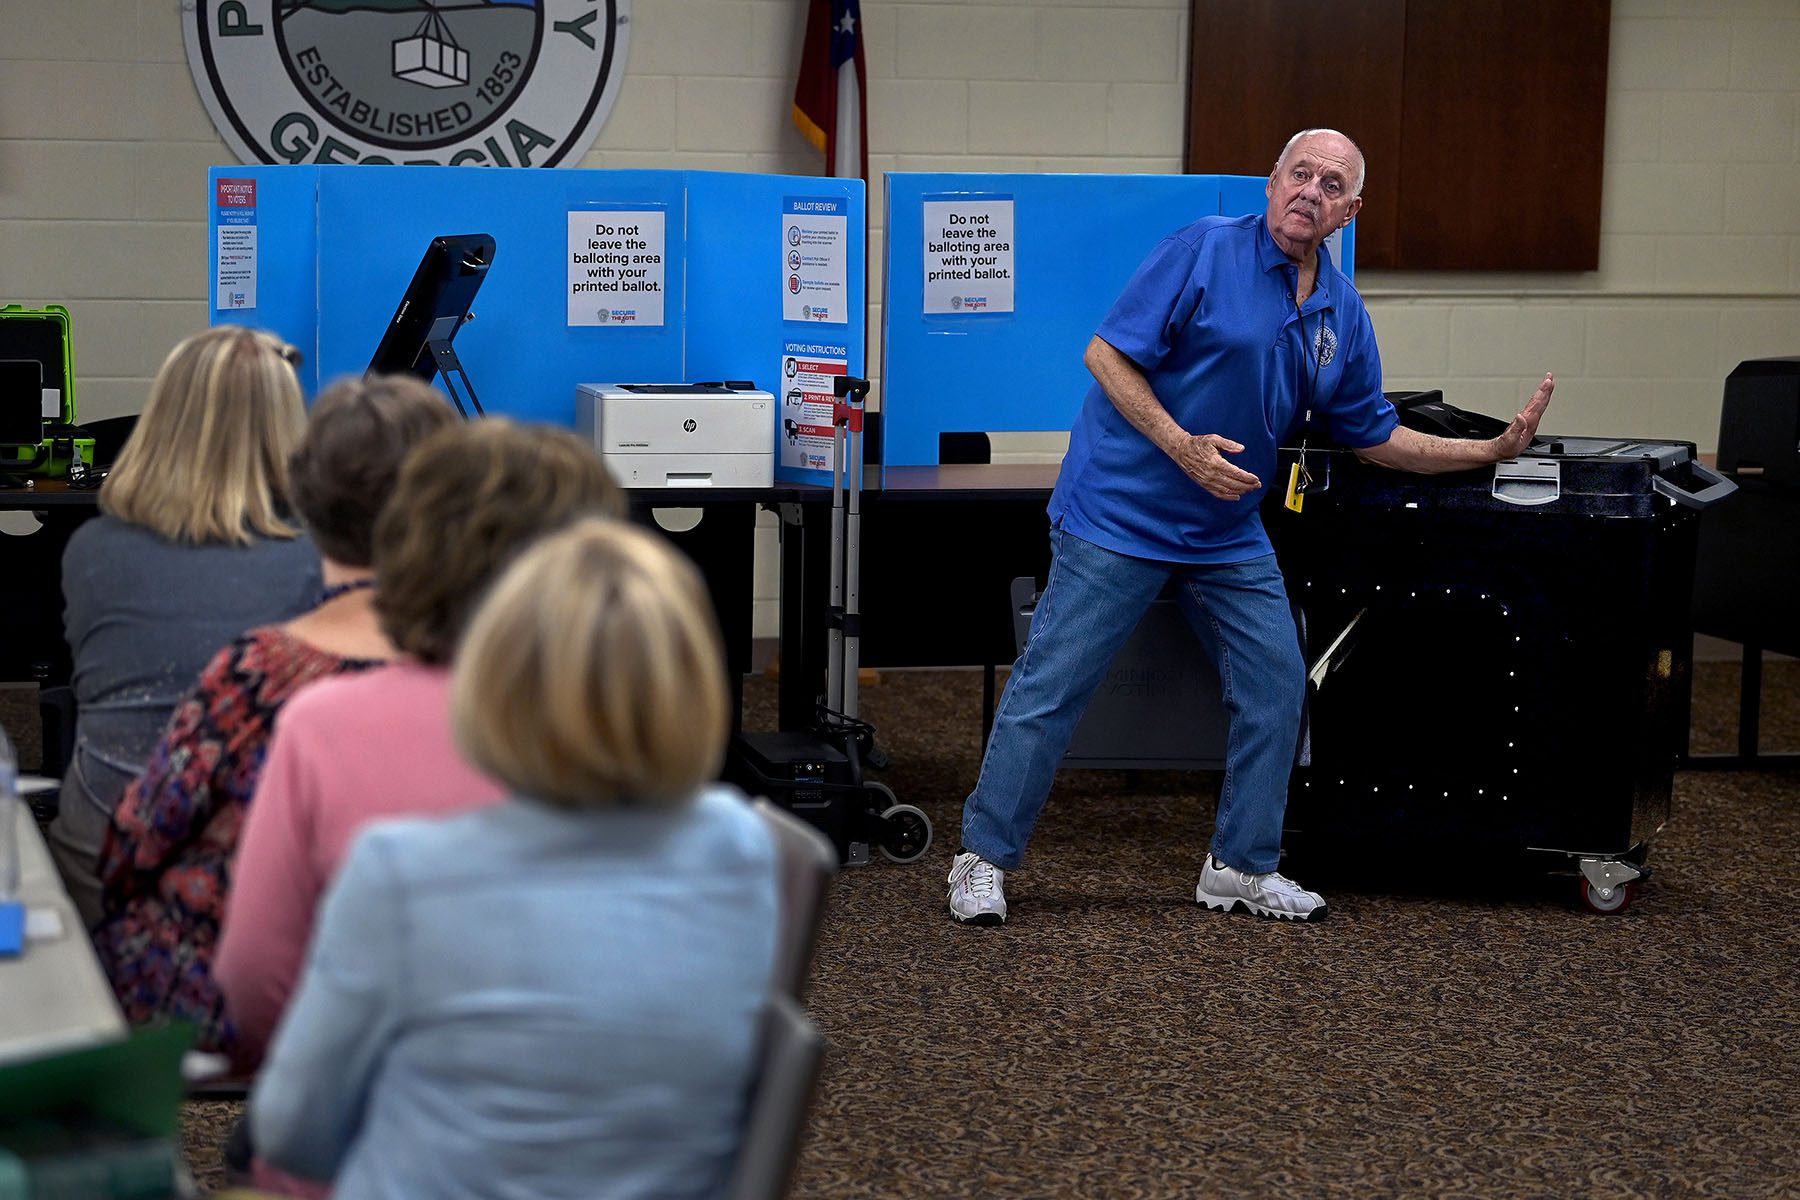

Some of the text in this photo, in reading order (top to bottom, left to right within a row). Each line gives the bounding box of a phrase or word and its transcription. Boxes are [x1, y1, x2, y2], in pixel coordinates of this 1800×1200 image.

[296, 46, 521, 137] ESTABLISHED 1853
[794, 202, 837, 211] BALLOT REVIEW
[950, 214, 989, 224] Do not
[596, 225, 639, 235] Do not
[942, 228, 996, 238] leave the
[588, 239, 646, 249] leave the
[929, 242, 1009, 254] balloting area
[574, 253, 660, 266] balloting area
[942, 255, 997, 268] with your
[587, 267, 647, 280] with your
[929, 269, 1010, 282] printed ballot.
[573, 281, 661, 294] printed ballot.
[785, 344, 846, 355] VOTING INSTRUCTIONS
